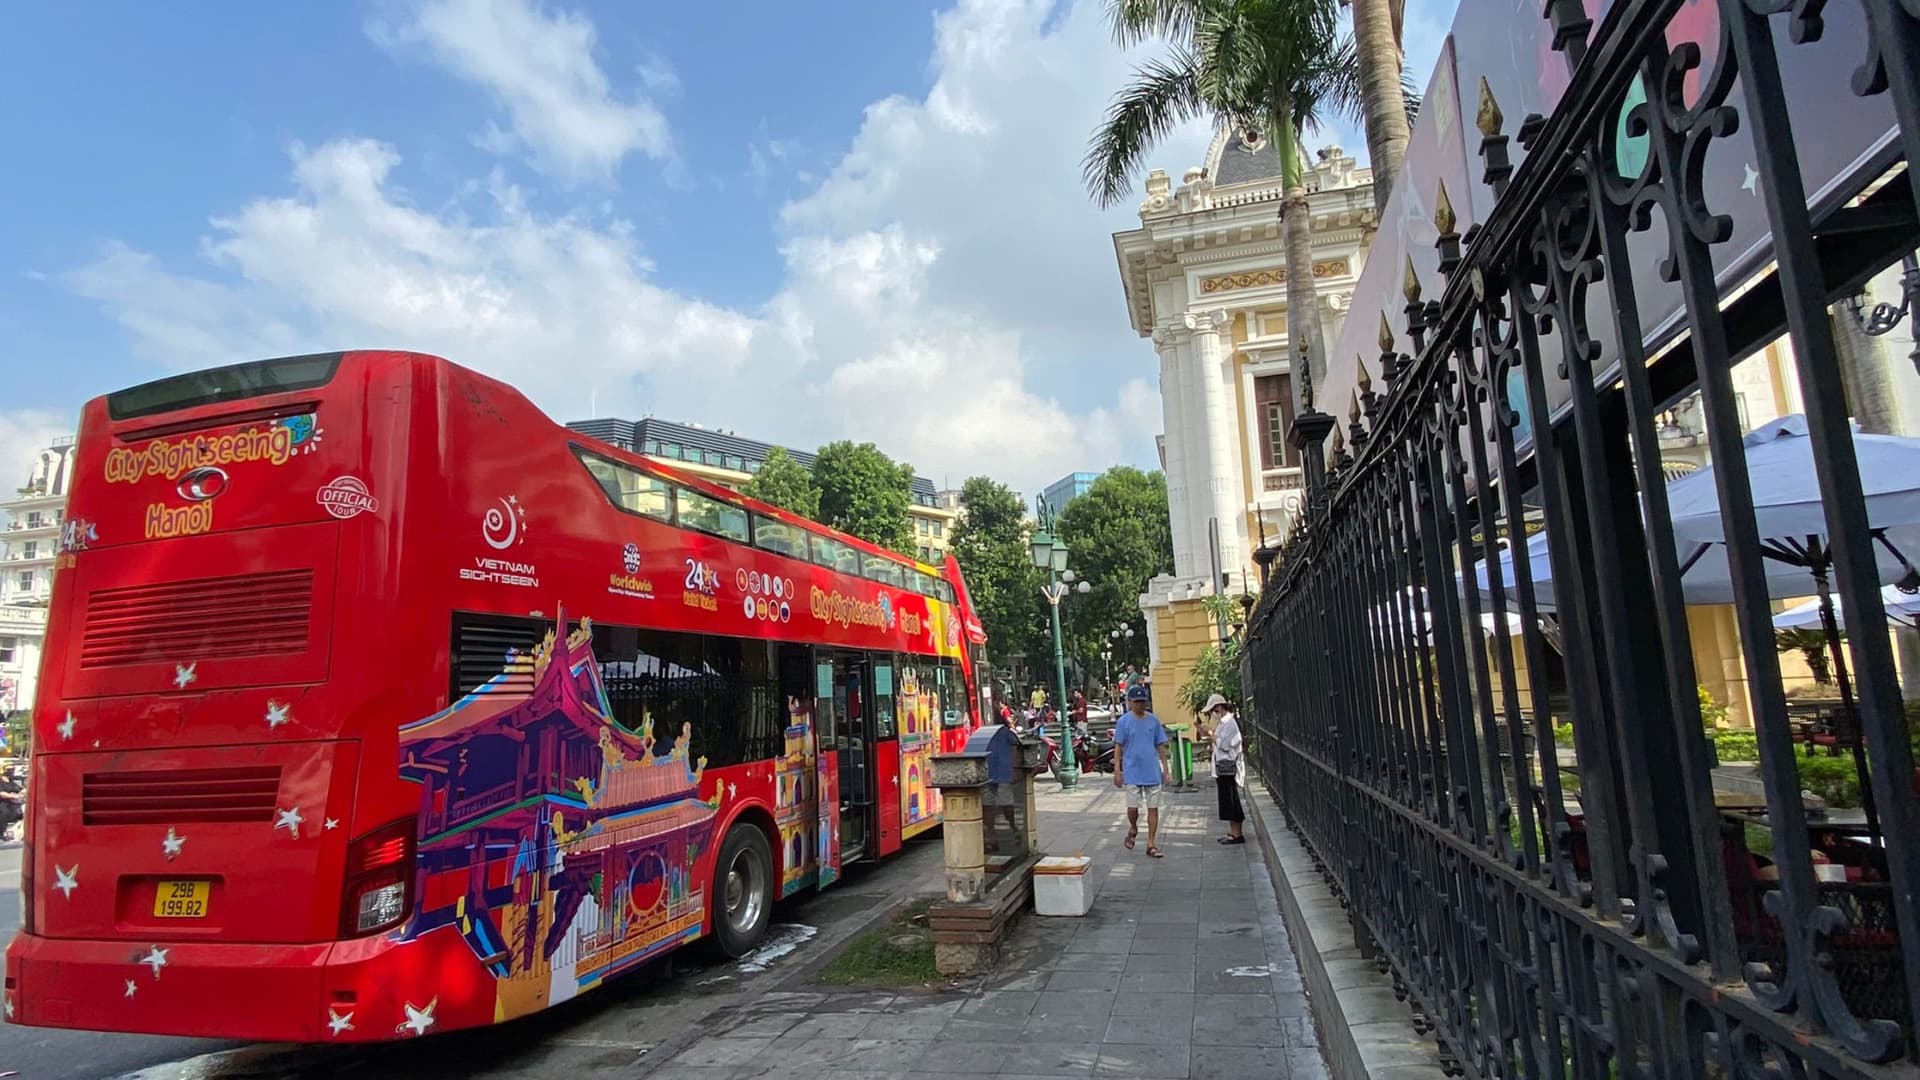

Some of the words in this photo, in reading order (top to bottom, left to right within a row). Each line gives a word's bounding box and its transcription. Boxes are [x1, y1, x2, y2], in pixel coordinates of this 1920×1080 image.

[323, 489, 373, 509] OFFICIAL
[145, 500, 212, 539] Hanoi
[333, 504, 356, 516] TOUR
[475, 556, 535, 575] VIETNAM
[684, 558, 704, 592] 24
[171, 883, 195, 898] 29B
[161, 900, 202, 916] 199.82
